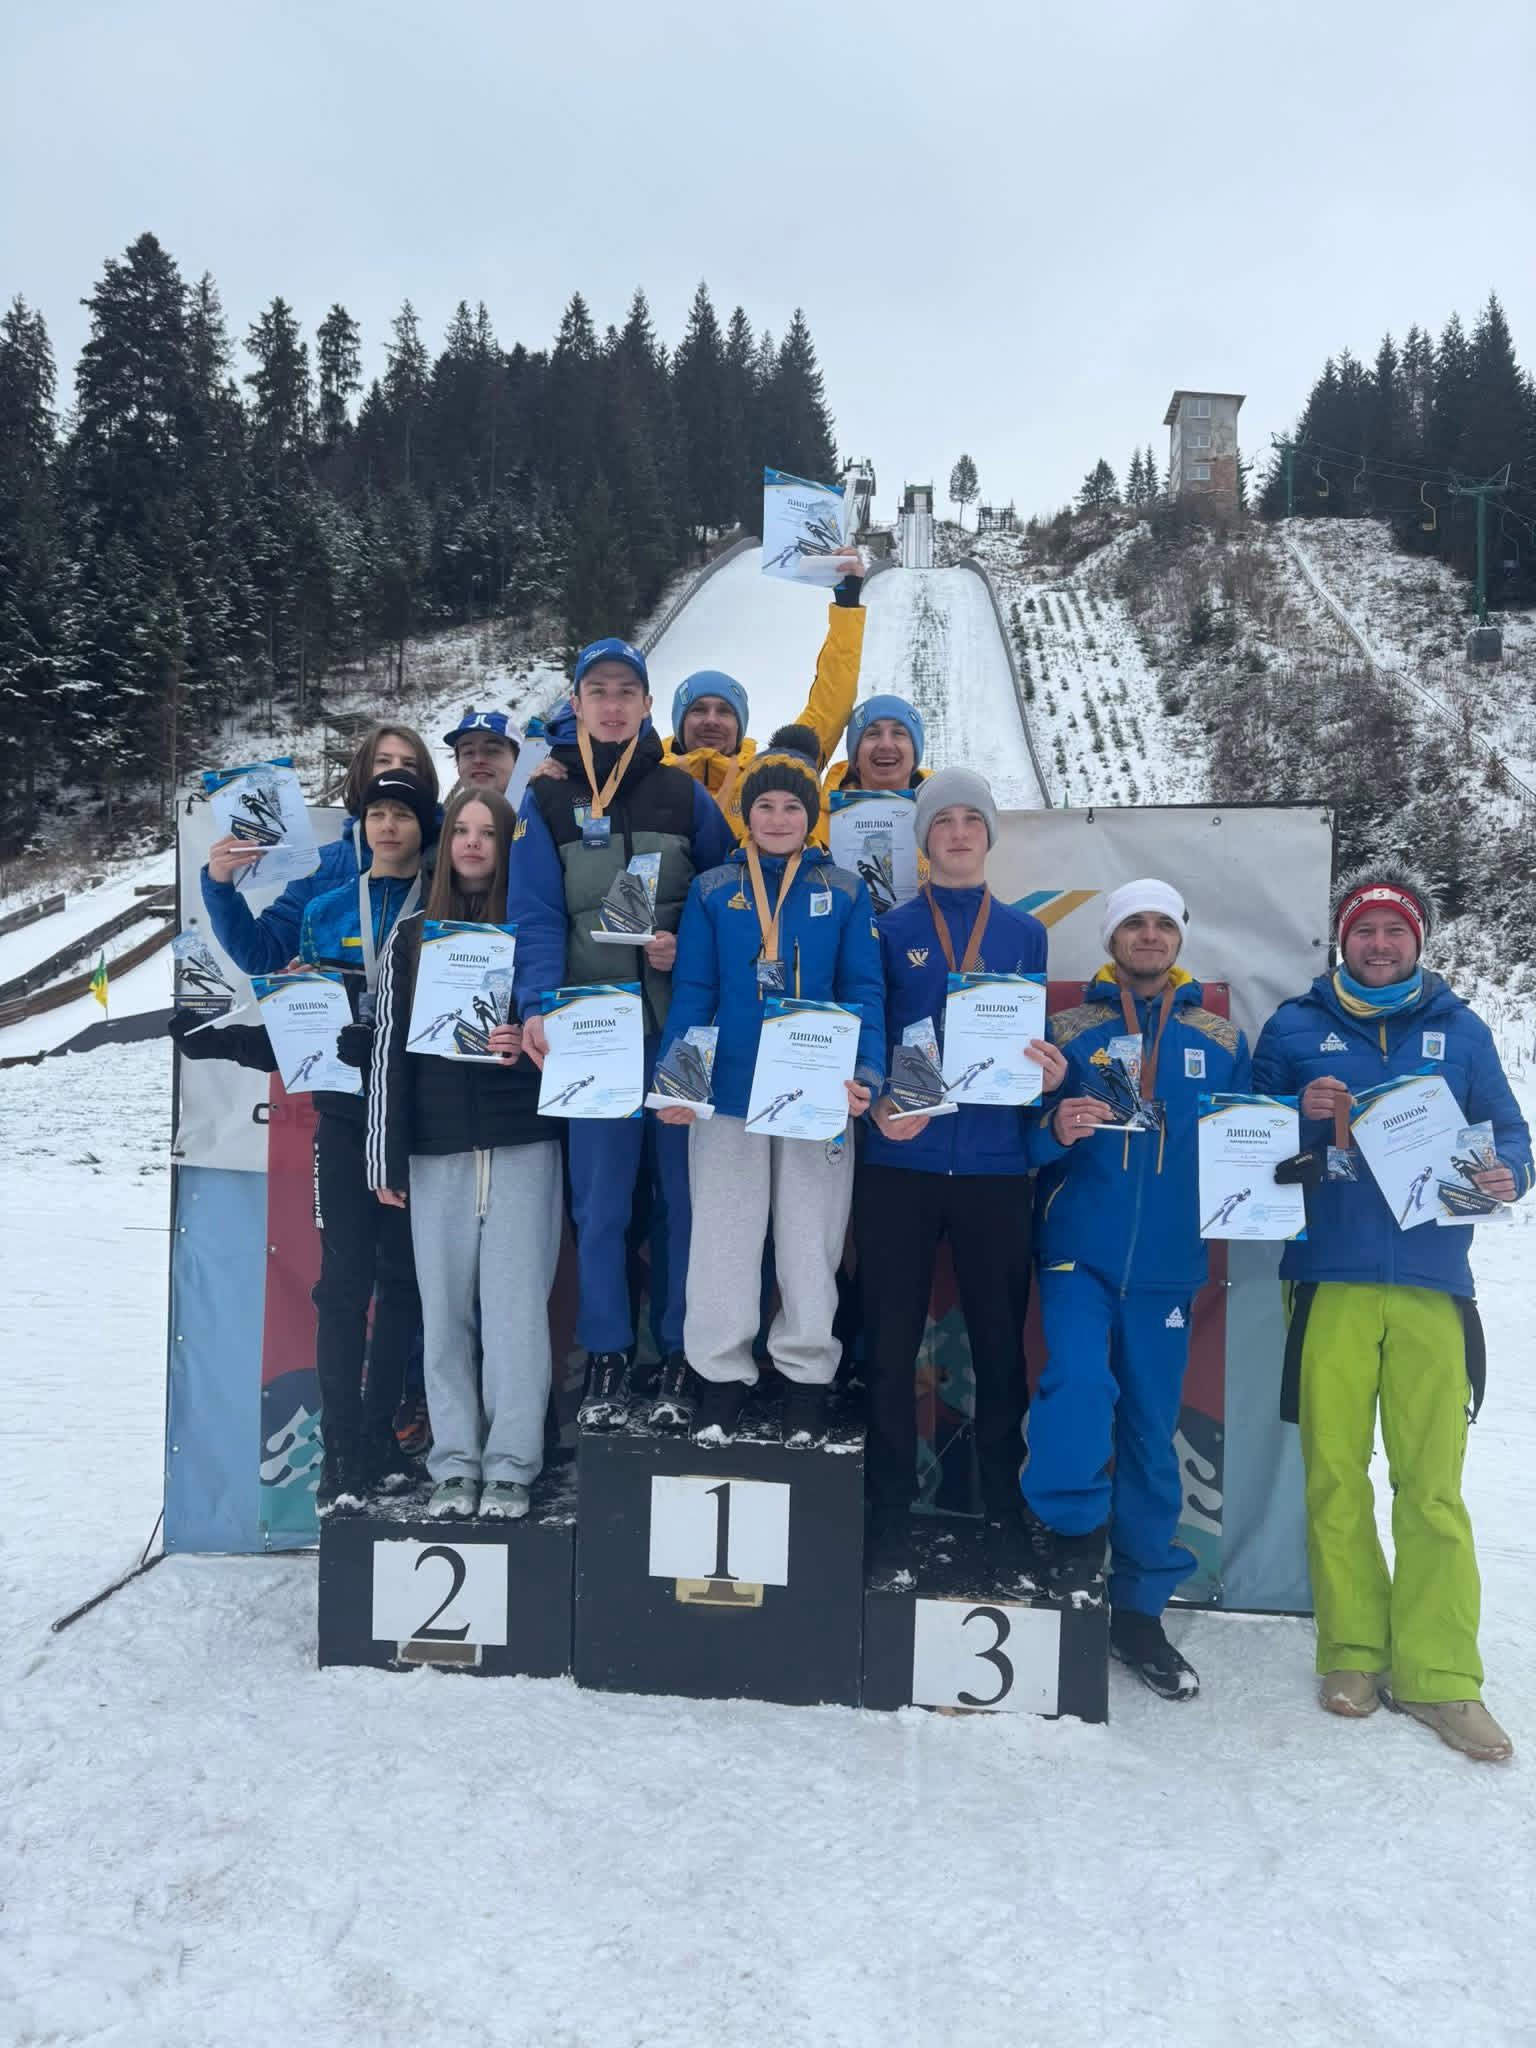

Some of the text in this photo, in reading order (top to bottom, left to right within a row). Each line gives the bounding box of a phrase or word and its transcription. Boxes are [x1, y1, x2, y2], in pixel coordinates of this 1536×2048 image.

[448, 952, 490, 964] ДИПЛОМ
[975, 1003, 1019, 1014] ДИПЛОМ
[572, 1019, 617, 1031] ДИПЛОМ
[788, 1031, 833, 1044] ДИПЛОМ
[1382, 1105, 1428, 1131] ДИПЛОМ
[1226, 1128, 1271, 1139] ДИПЛОМ
[313, 1154, 324, 1229] UKRAINE
[703, 1482, 739, 1581] 1
[411, 1545, 471, 1641] 2
[957, 1606, 1015, 1705] 3
